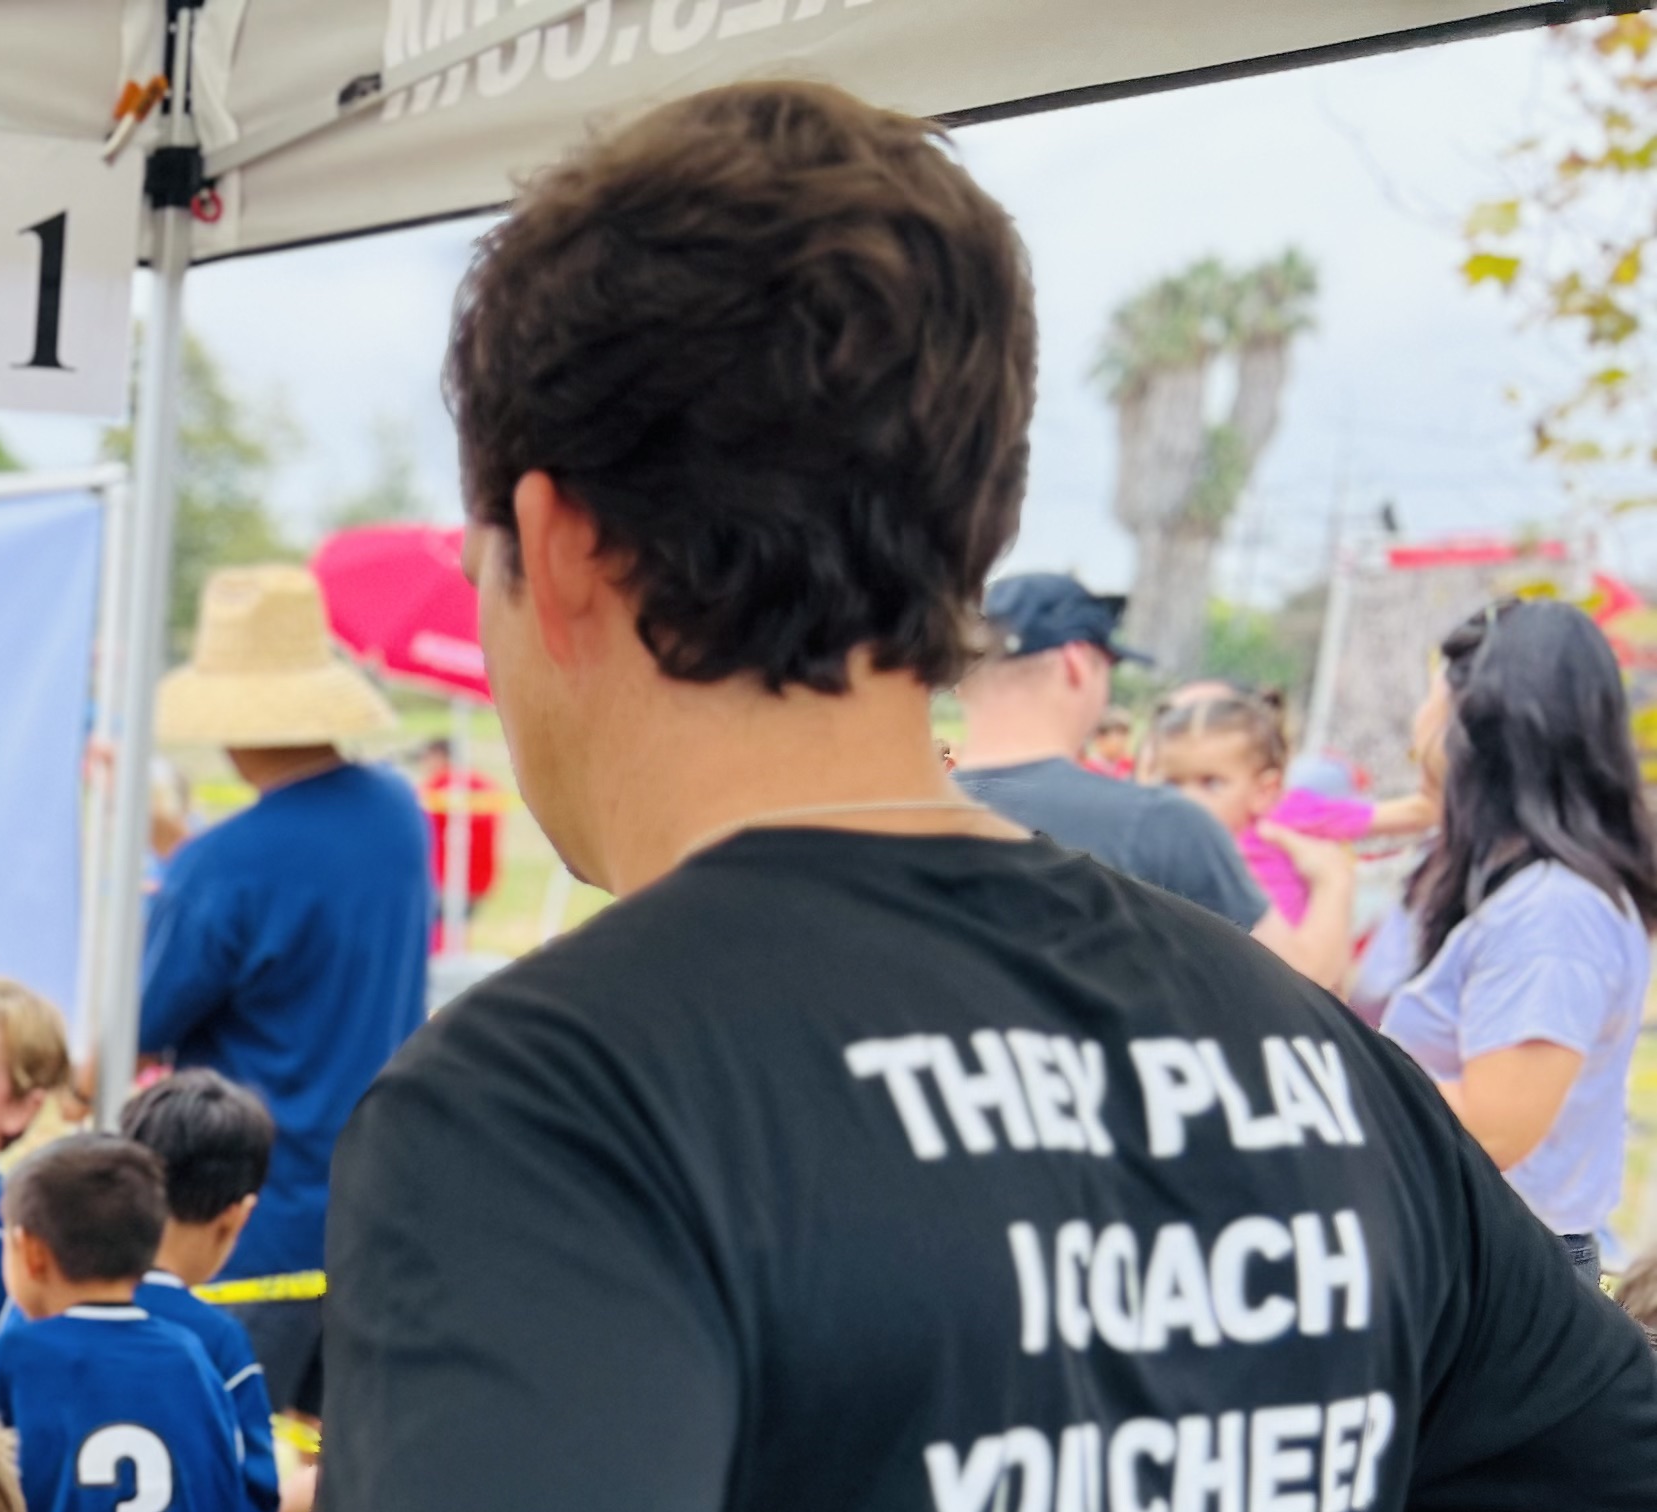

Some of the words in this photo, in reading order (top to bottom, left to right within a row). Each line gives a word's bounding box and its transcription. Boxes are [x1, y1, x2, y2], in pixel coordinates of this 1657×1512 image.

[11, 210, 77, 372] 1
[845, 1029, 1113, 1159] THEY
[1129, 1036, 1365, 1157] PLAY
[1008, 1221, 1045, 1354] I
[1055, 1209, 1370, 1351] COACH
